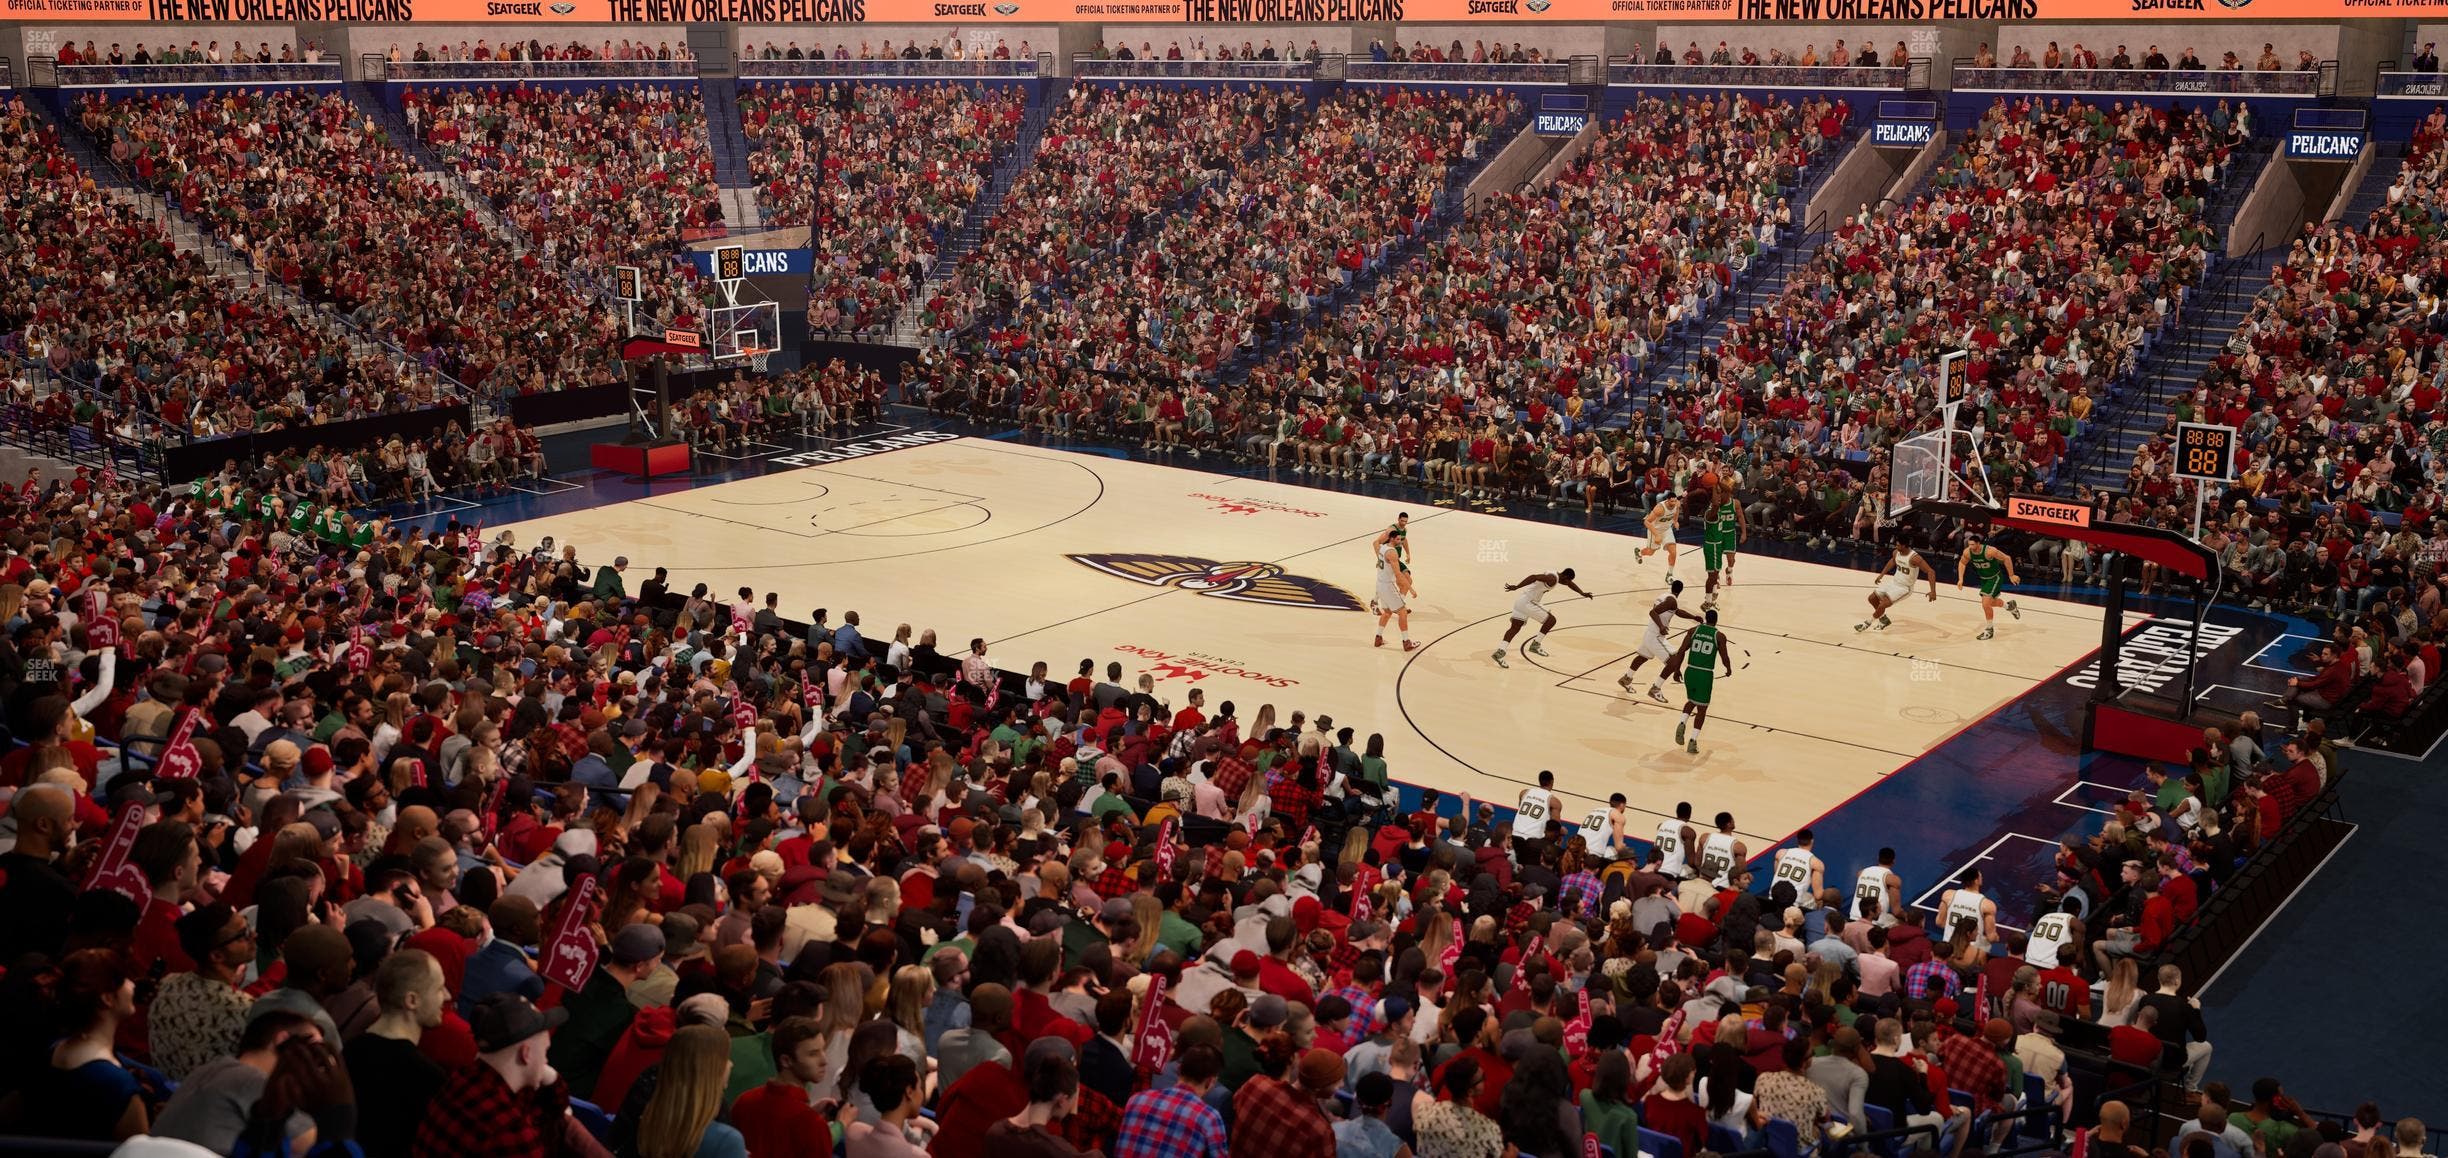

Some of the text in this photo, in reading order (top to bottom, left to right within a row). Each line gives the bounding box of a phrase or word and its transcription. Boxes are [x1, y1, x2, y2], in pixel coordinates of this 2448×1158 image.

[8, 0, 142, 12] OFFICIAL TICKETING PARTNER OF
[149, 0, 412, 20] THE NEW ORLEANS PELICANS
[488, 2, 542, 16] SEATGEEK
[608, 0, 865, 22] THE NEW ORLEANS PELICANS
[935, 3, 987, 16] SEATGEEK
[1076, 5, 1180, 14] OFFICIAL TICKETING PARTNER OF
[1183, 0, 1403, 21] THE NEW ORLEANS PELICANS
[1468, 0, 1518, 14] SEATGEEK
[1613, 0, 1731, 11] OFFICIAL TICKETING PARTNER OF
[1776, 0, 1820, 19] NEW
[1826, 0, 1924, 19] ORLEANS
[1929, 0, 2037, 19] PELICANS
[1538, 116, 1583, 132] PELICANS
[1876, 124, 1930, 142] PELICANS
[2291, 135, 2359, 155] PELICANS
[710, 252, 788, 274] CANS
[724, 261, 738, 278] 88
[621, 280, 633, 297] 88
[668, 332, 697, 345] SEATGEEK
[1951, 375, 1962, 398] 88
[2186, 430, 2224, 448] 88 88
[768, 431, 960, 467] PELICANS
[2188, 448, 2218, 474] 88
[2017, 503, 2080, 523] SEATGEEK
[1692, 639, 1714, 655] 00
[1114, 644, 1300, 688] SMOOTHIE KING
[1188, 651, 1245, 667] CENTER
[1519, 801, 1545, 820] 00
[1581, 814, 1605, 832] 00
[1655, 835, 1676, 853] 00
[1778, 863, 1806, 883] 00
[1856, 883, 1880, 900] 00
[1953, 904, 1976, 912] PLAYER
[2034, 921, 2063, 942] 00
[2047, 981, 2069, 1010] 00
